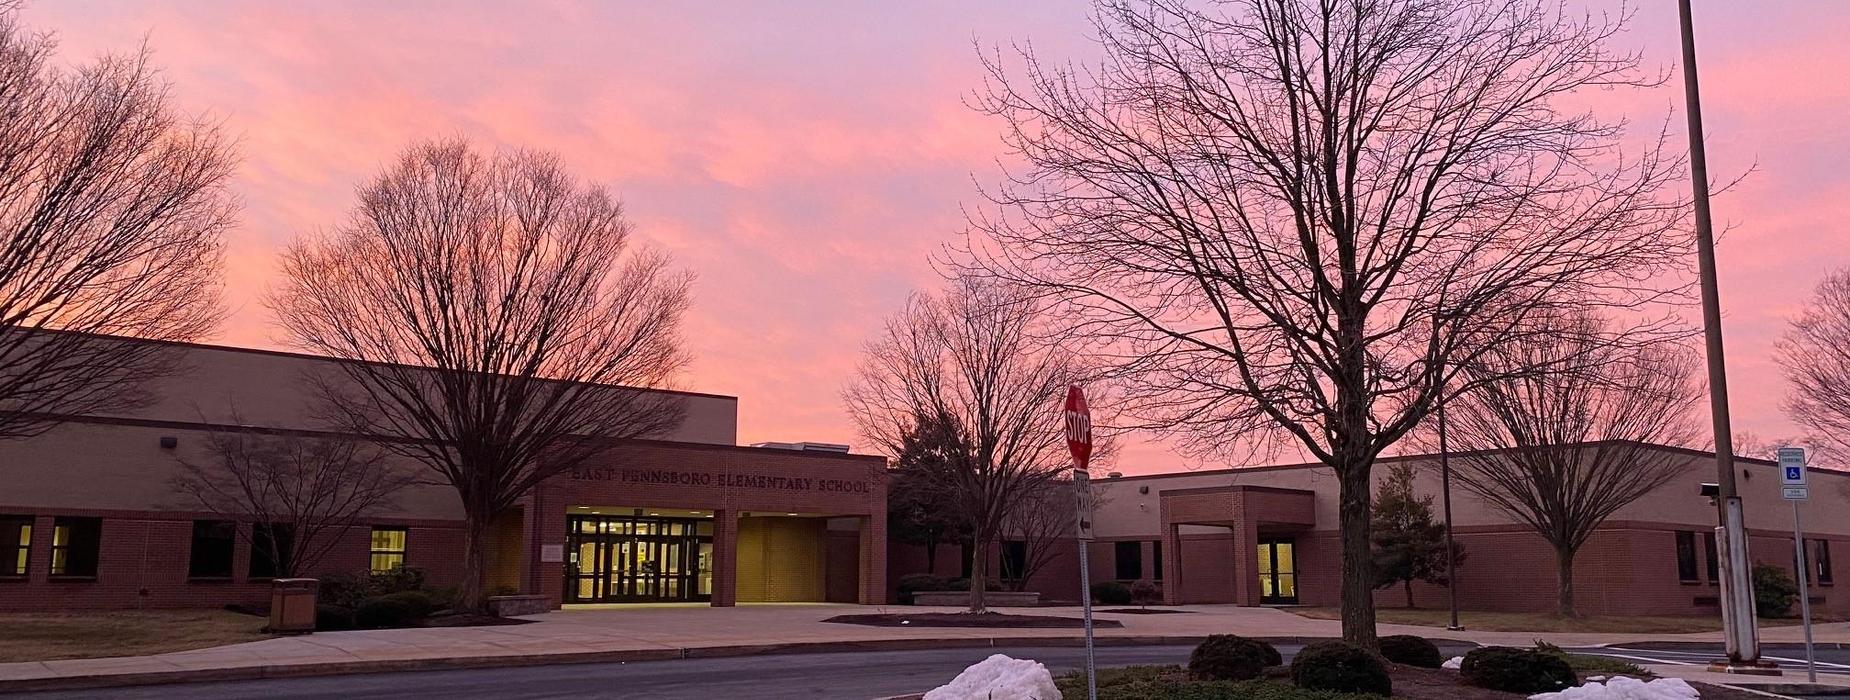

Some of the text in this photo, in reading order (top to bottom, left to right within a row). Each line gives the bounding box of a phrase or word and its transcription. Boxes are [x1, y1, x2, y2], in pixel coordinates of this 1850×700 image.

[1067, 409, 1090, 444] STOP
[622, 469, 710, 486] PENNSBORO
[718, 474, 812, 490] ELEMENTARY
[819, 480, 870, 493] SCHOOL
[1076, 477, 1088, 494] ONE
